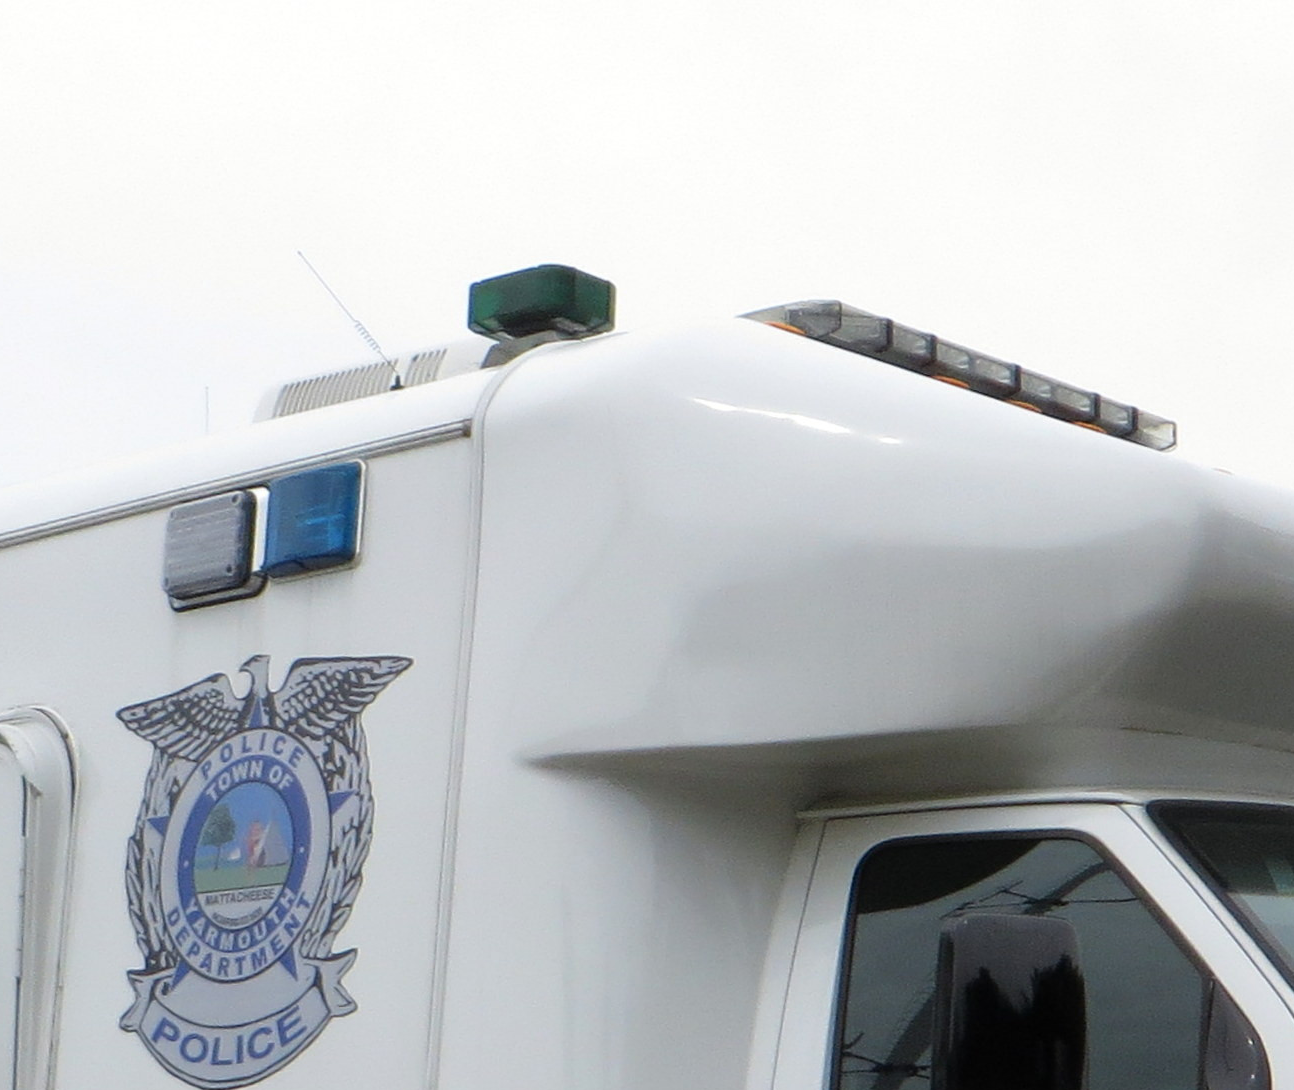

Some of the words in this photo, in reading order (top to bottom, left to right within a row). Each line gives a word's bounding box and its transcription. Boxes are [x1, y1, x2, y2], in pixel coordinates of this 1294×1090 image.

[202, 732, 305, 778] POLICE
[207, 759, 263, 801] TOWN
[268, 761, 293, 792] OF
[167, 890, 309, 978] DEPARTMENT
[186, 887, 298, 952] YARMOUTH
[151, 1004, 307, 1067] POLICE
